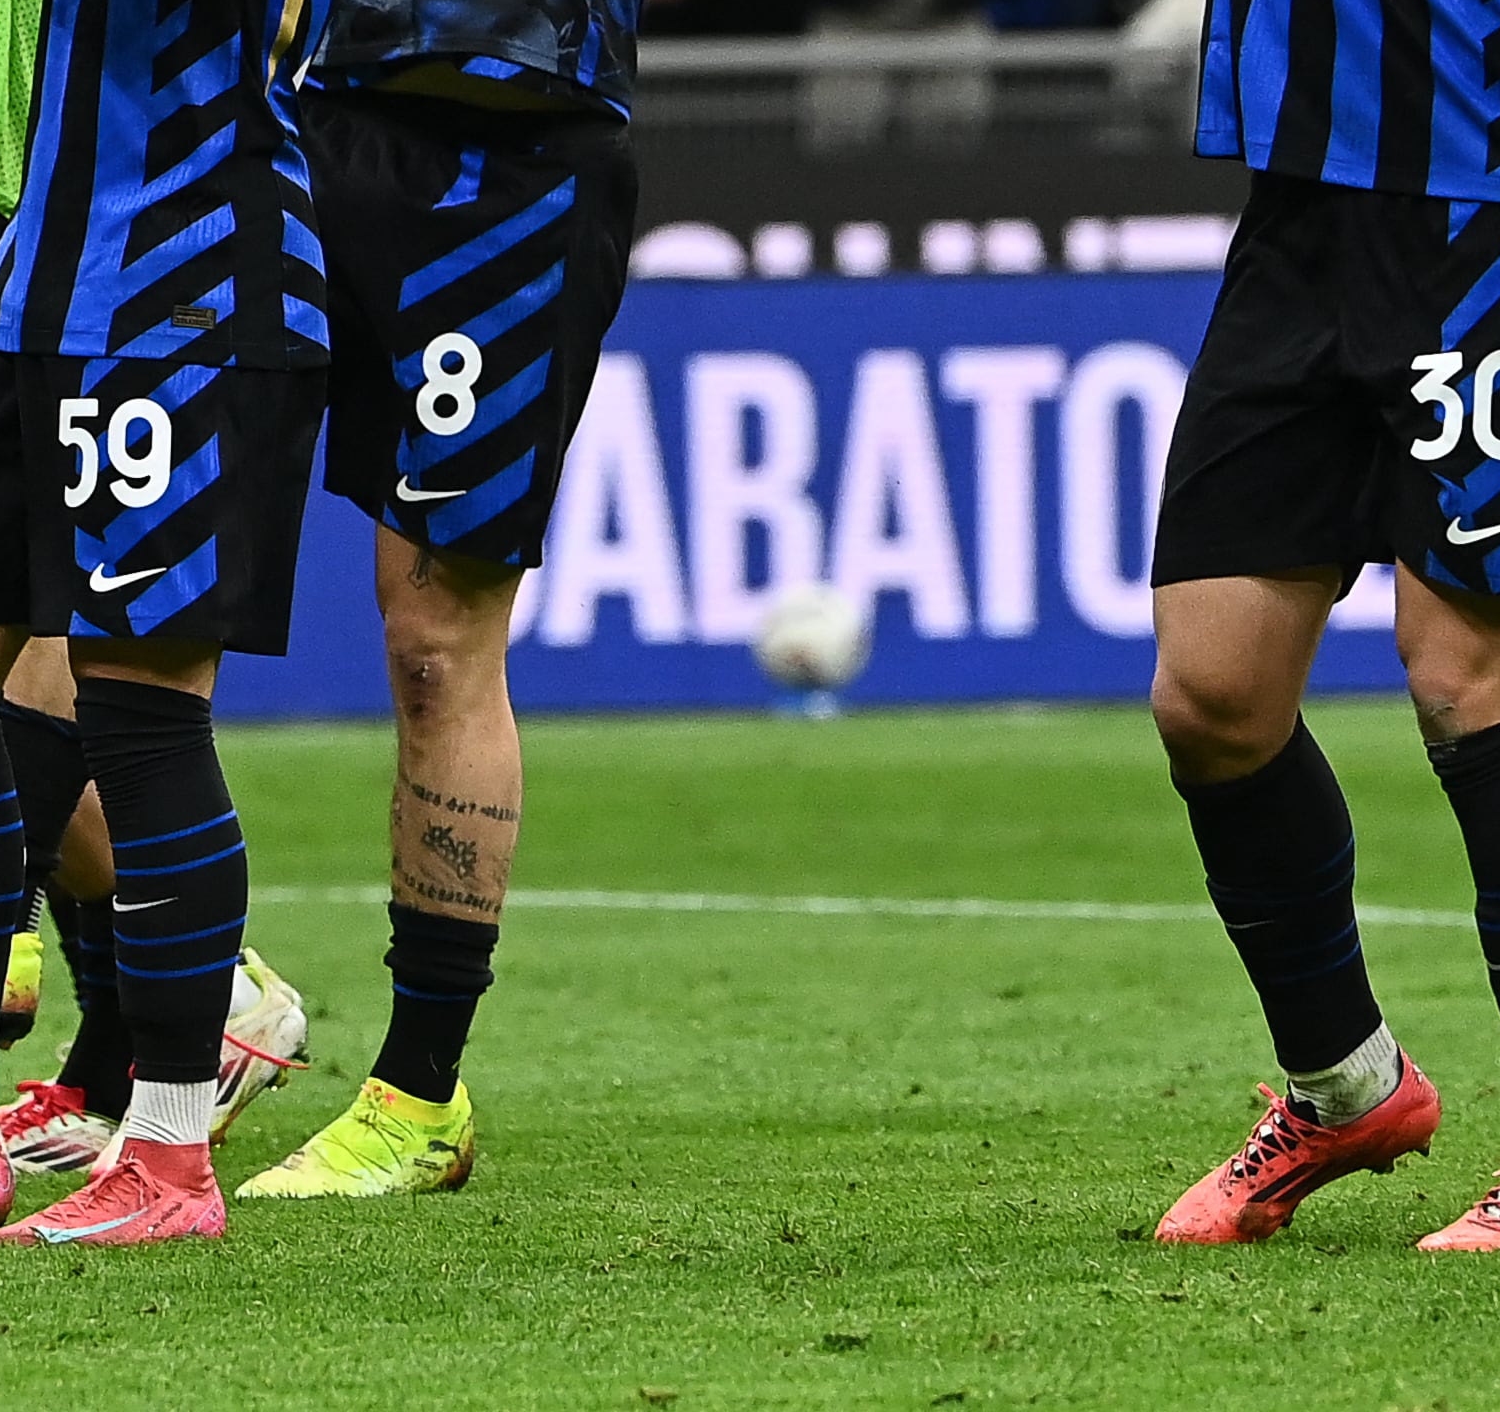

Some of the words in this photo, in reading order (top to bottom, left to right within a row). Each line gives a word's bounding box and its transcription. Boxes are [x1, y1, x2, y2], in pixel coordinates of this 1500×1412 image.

[416, 332, 483, 436] 8
[58, 398, 172, 508] 59
[507, 341, 1190, 647] ABATO
